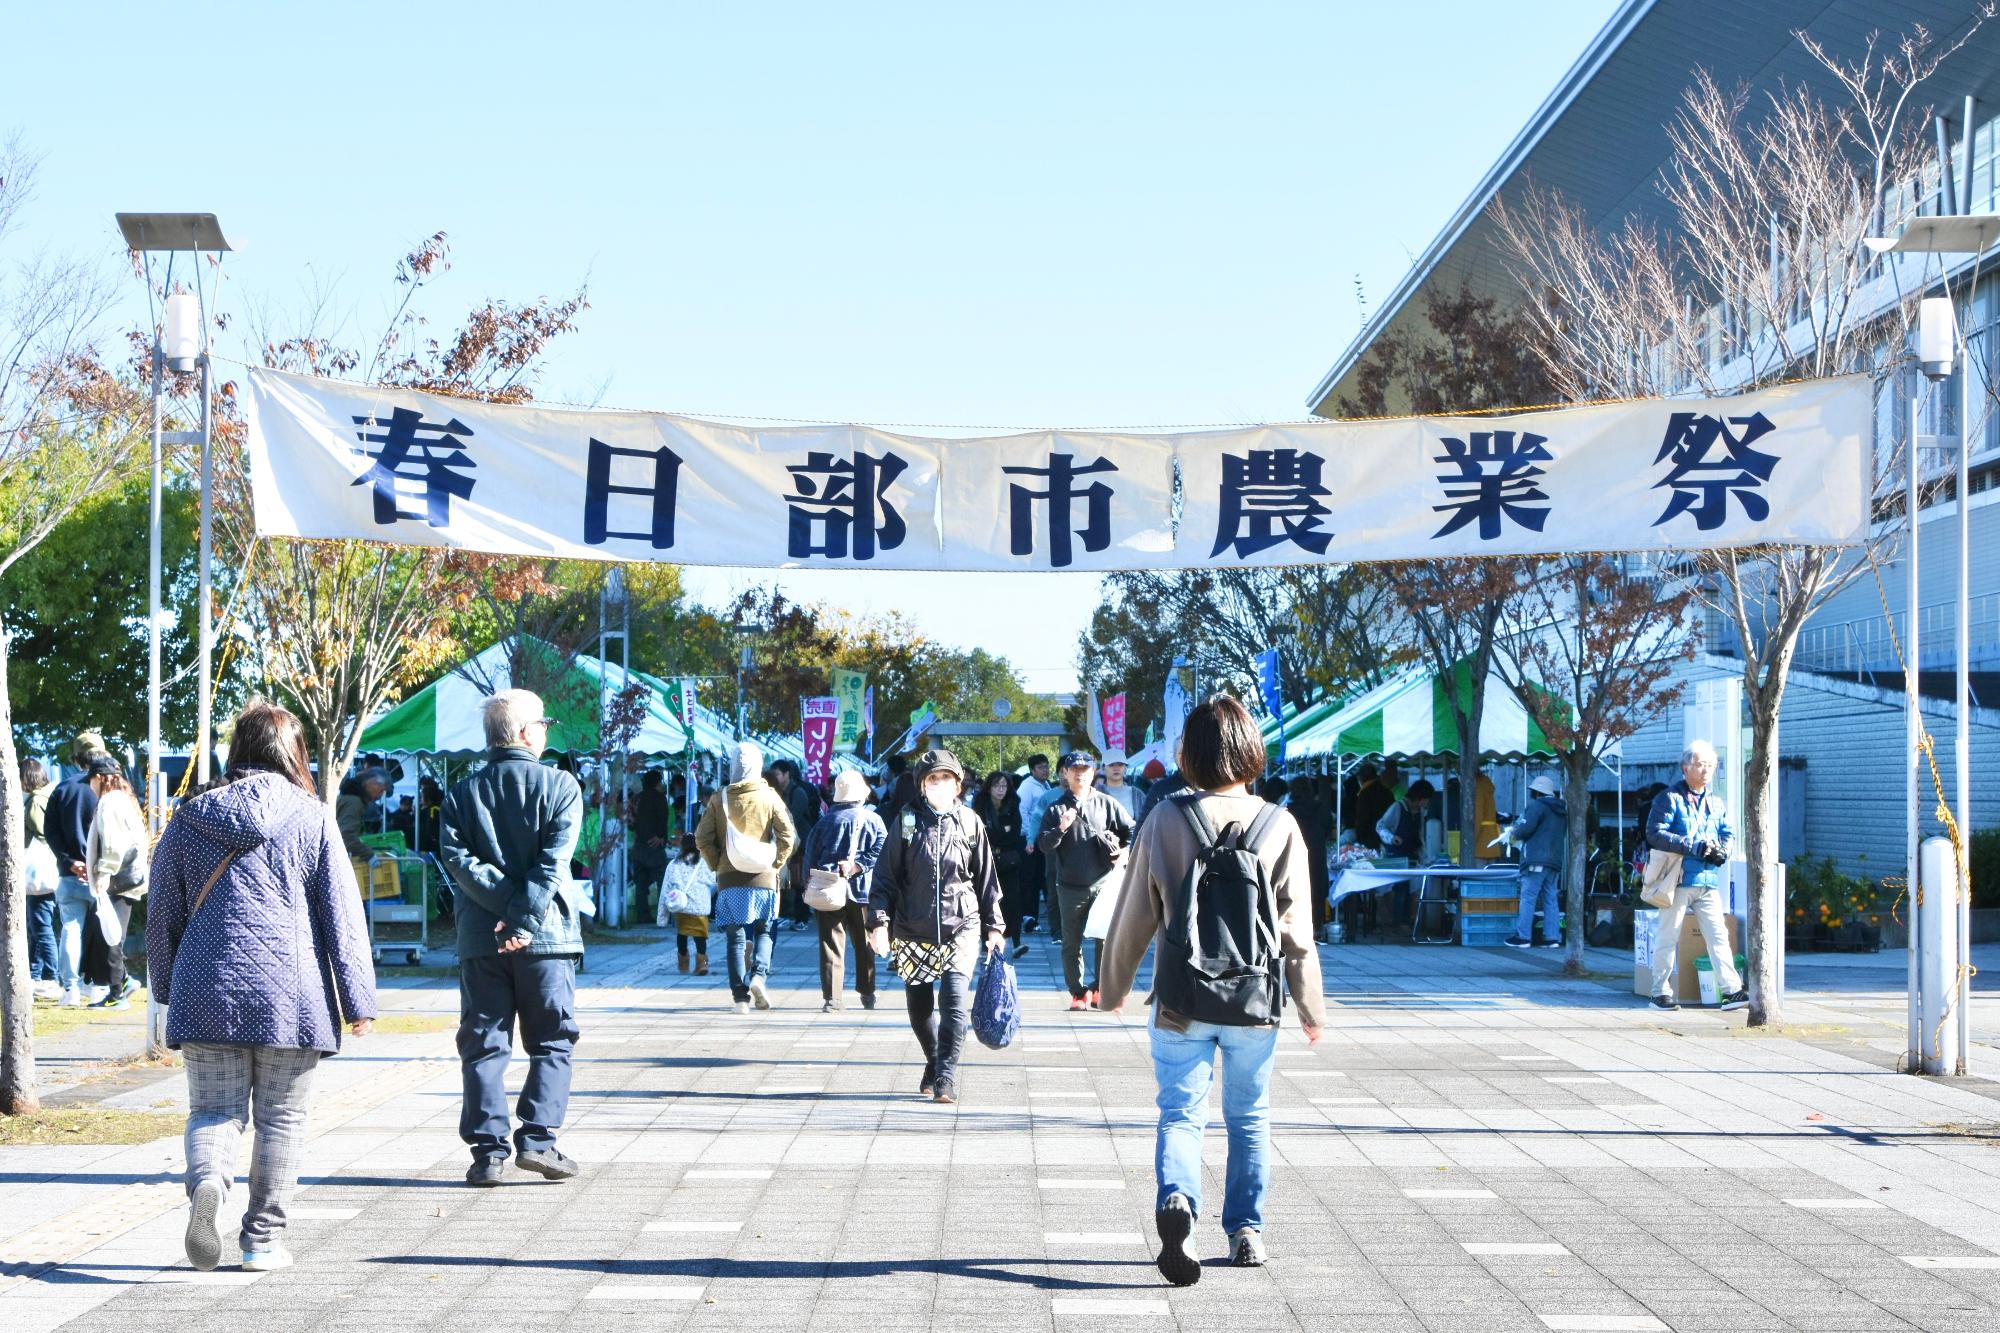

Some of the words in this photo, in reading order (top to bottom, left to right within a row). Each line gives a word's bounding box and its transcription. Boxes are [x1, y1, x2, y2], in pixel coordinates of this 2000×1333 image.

[350, 406, 1782, 568] 春日部市農業祭
